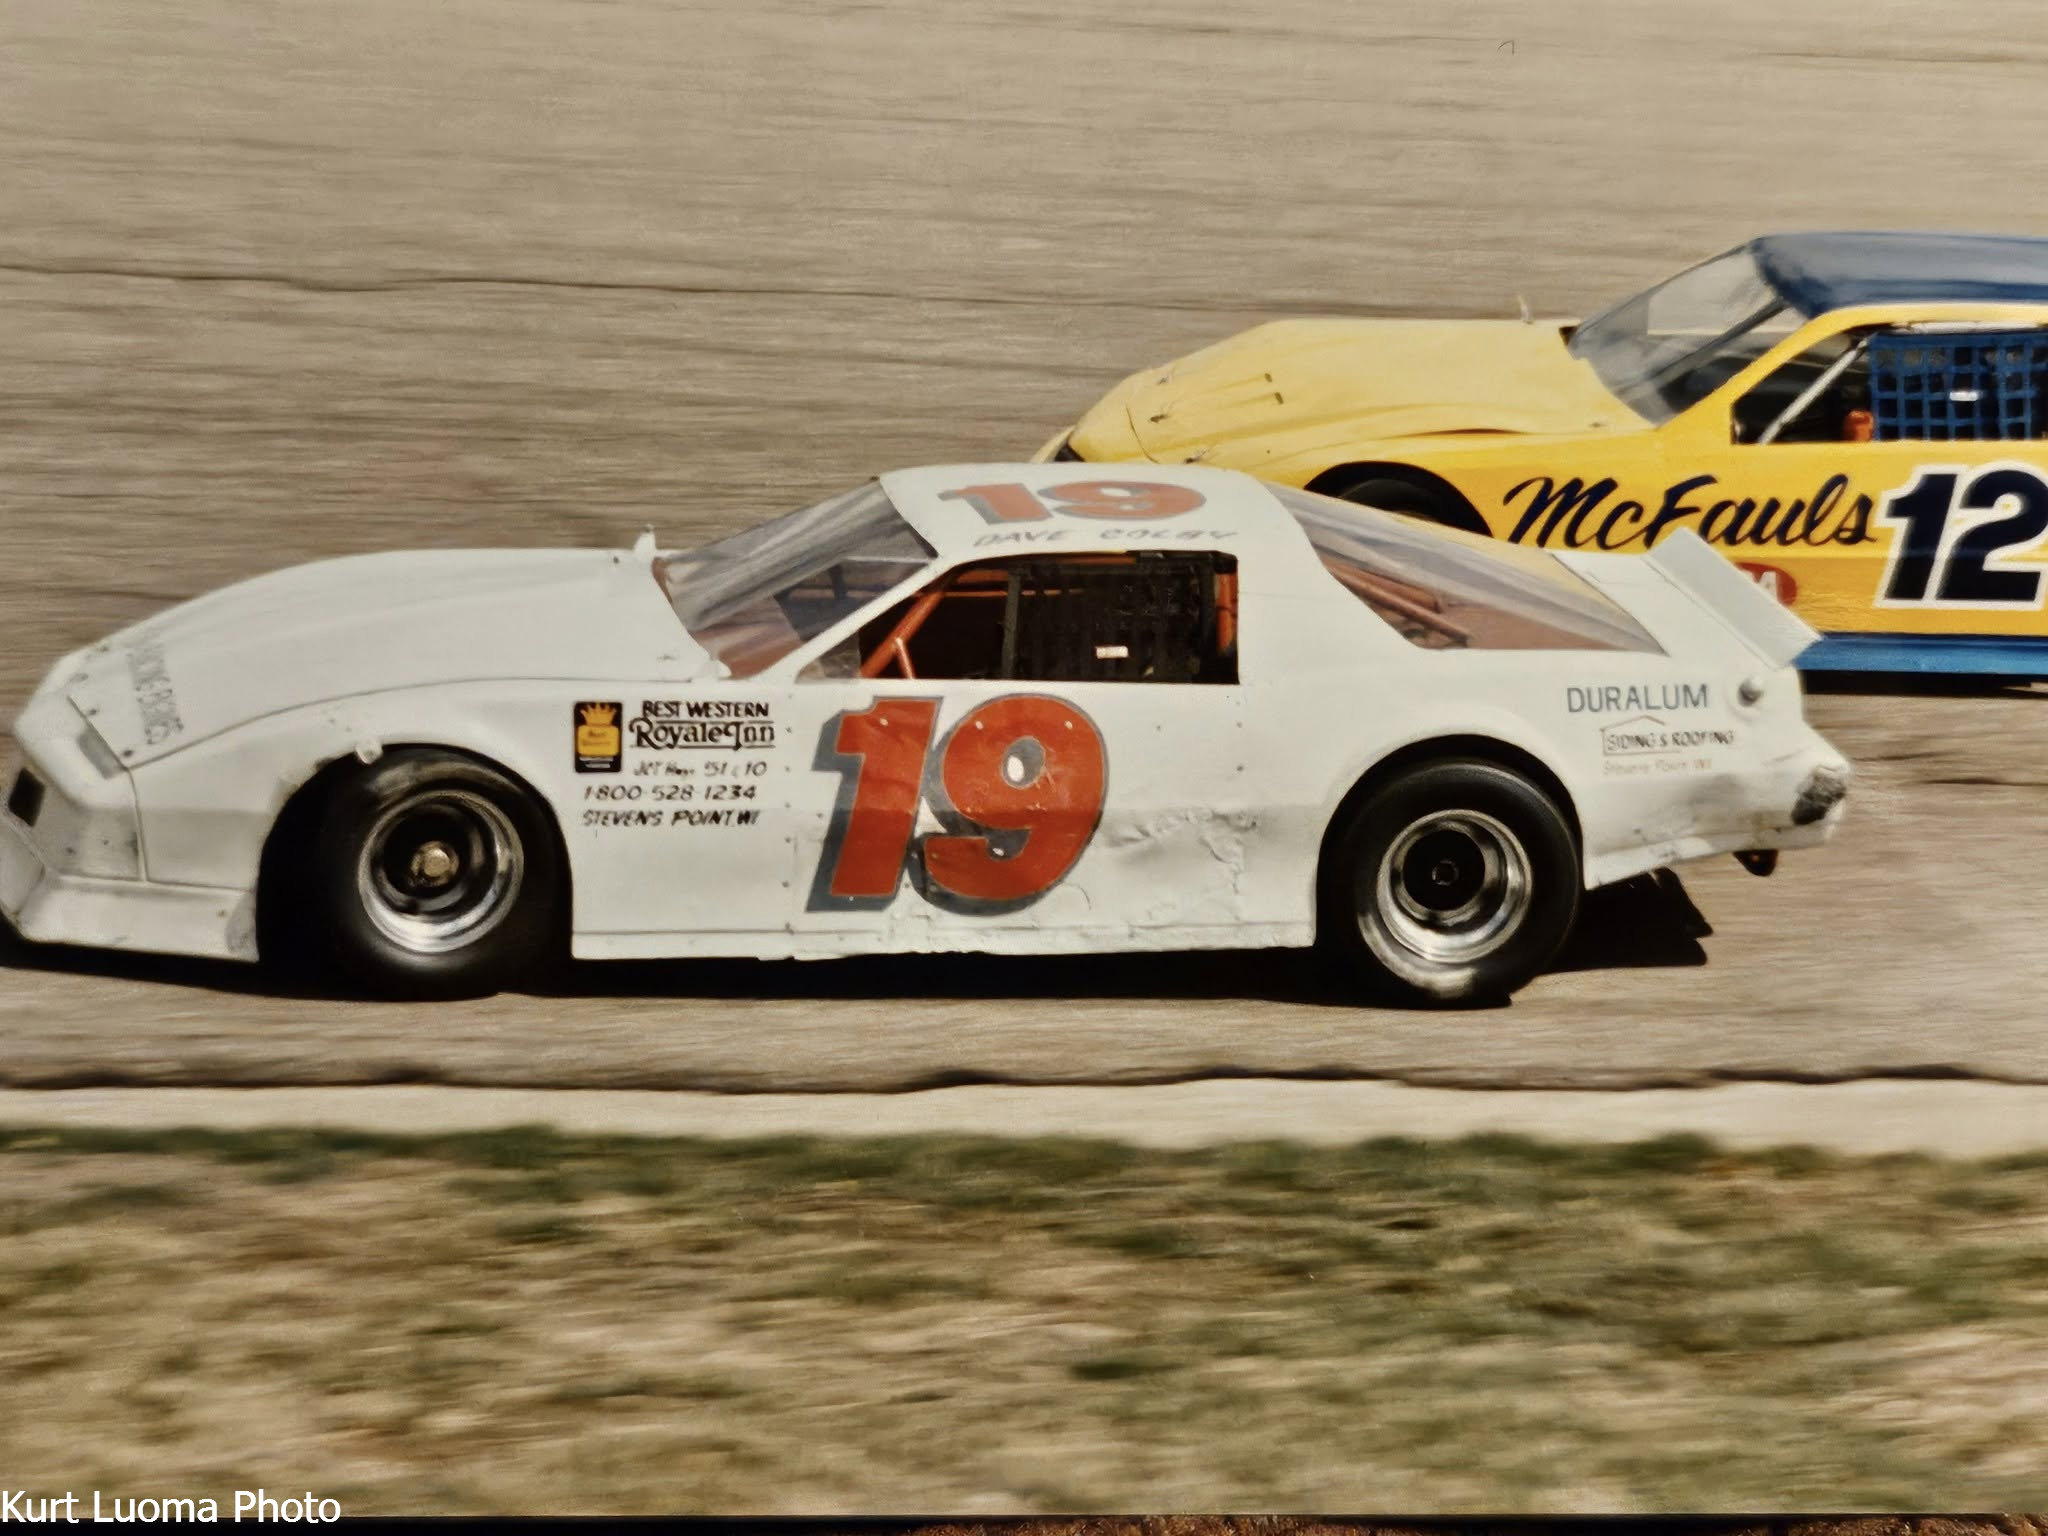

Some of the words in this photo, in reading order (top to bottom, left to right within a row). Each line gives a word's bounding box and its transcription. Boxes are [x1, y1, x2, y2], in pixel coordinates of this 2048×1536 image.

[937, 480, 1206, 525] 19
[1503, 473, 1877, 551] McFauls
[973, 529, 1070, 548] DAVE
[1873, 460, 2048, 611] 12
[642, 700, 681, 718] BEST
[686, 700, 770, 718] WESTERN
[1566, 683, 1709, 713] DURALUM
[629, 717, 723, 750] Royale
[744, 760, 768, 777] 10
[582, 808, 664, 826] STEVENS
[804, 693, 1109, 916] 19
